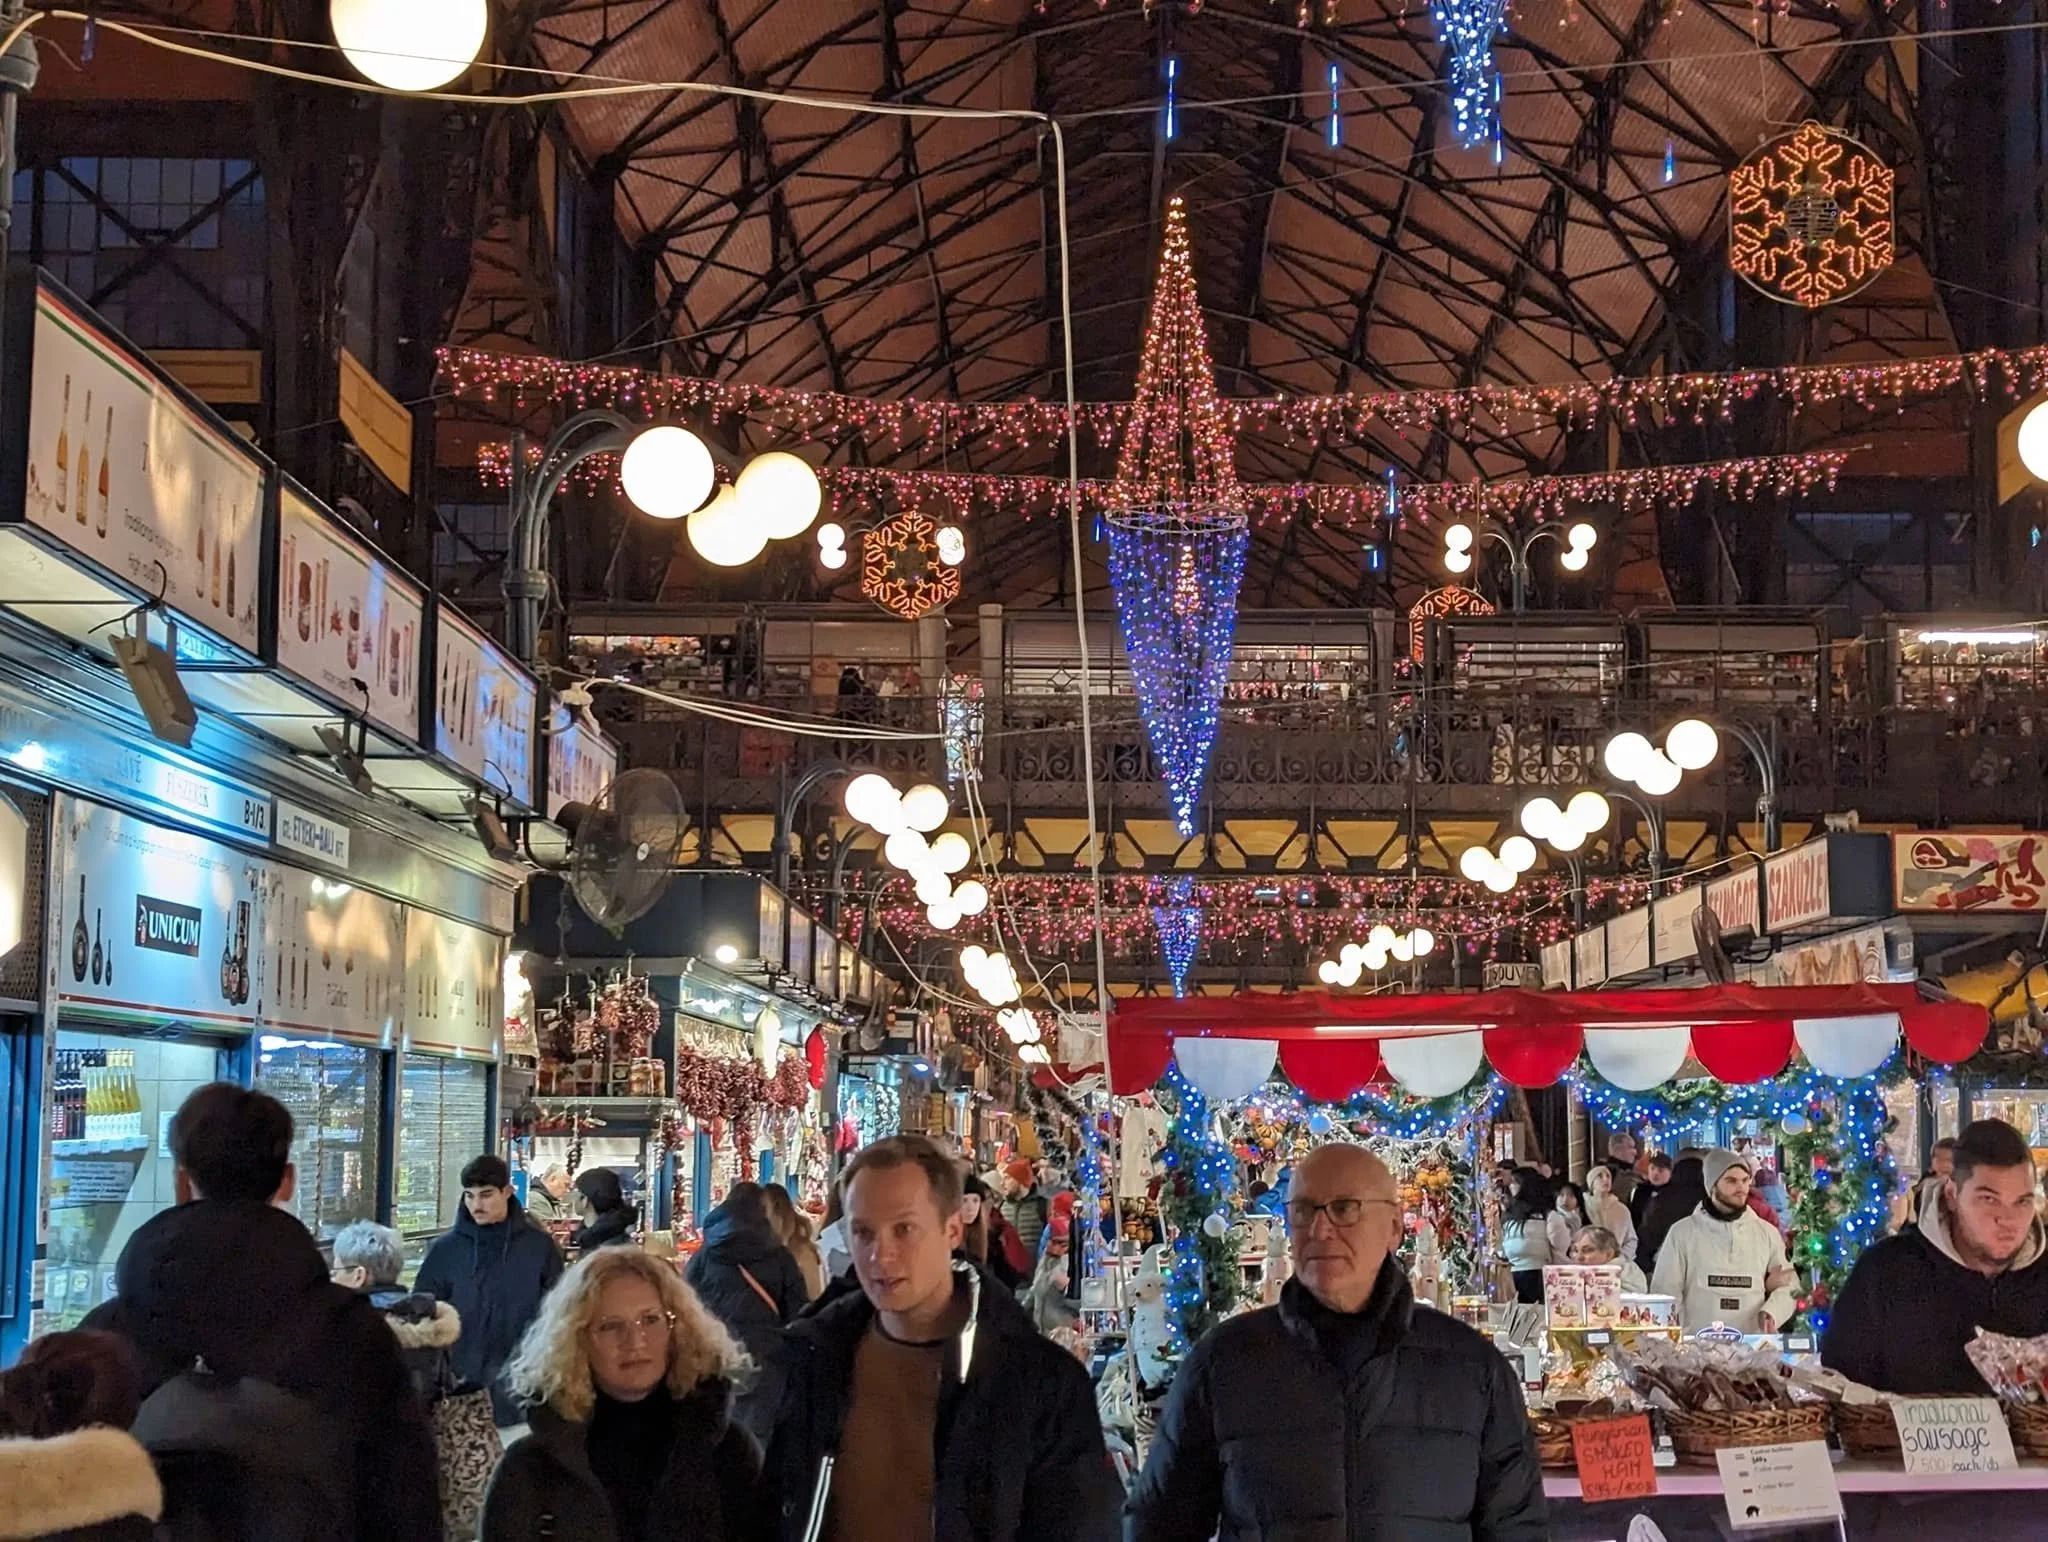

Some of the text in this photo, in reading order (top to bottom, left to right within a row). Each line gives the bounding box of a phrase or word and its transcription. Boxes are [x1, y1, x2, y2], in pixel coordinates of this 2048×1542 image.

[149, 911, 199, 946] UNICUM
[1583, 1440, 1644, 1465] SMOKED
[1602, 1459, 1641, 1480] HAM
